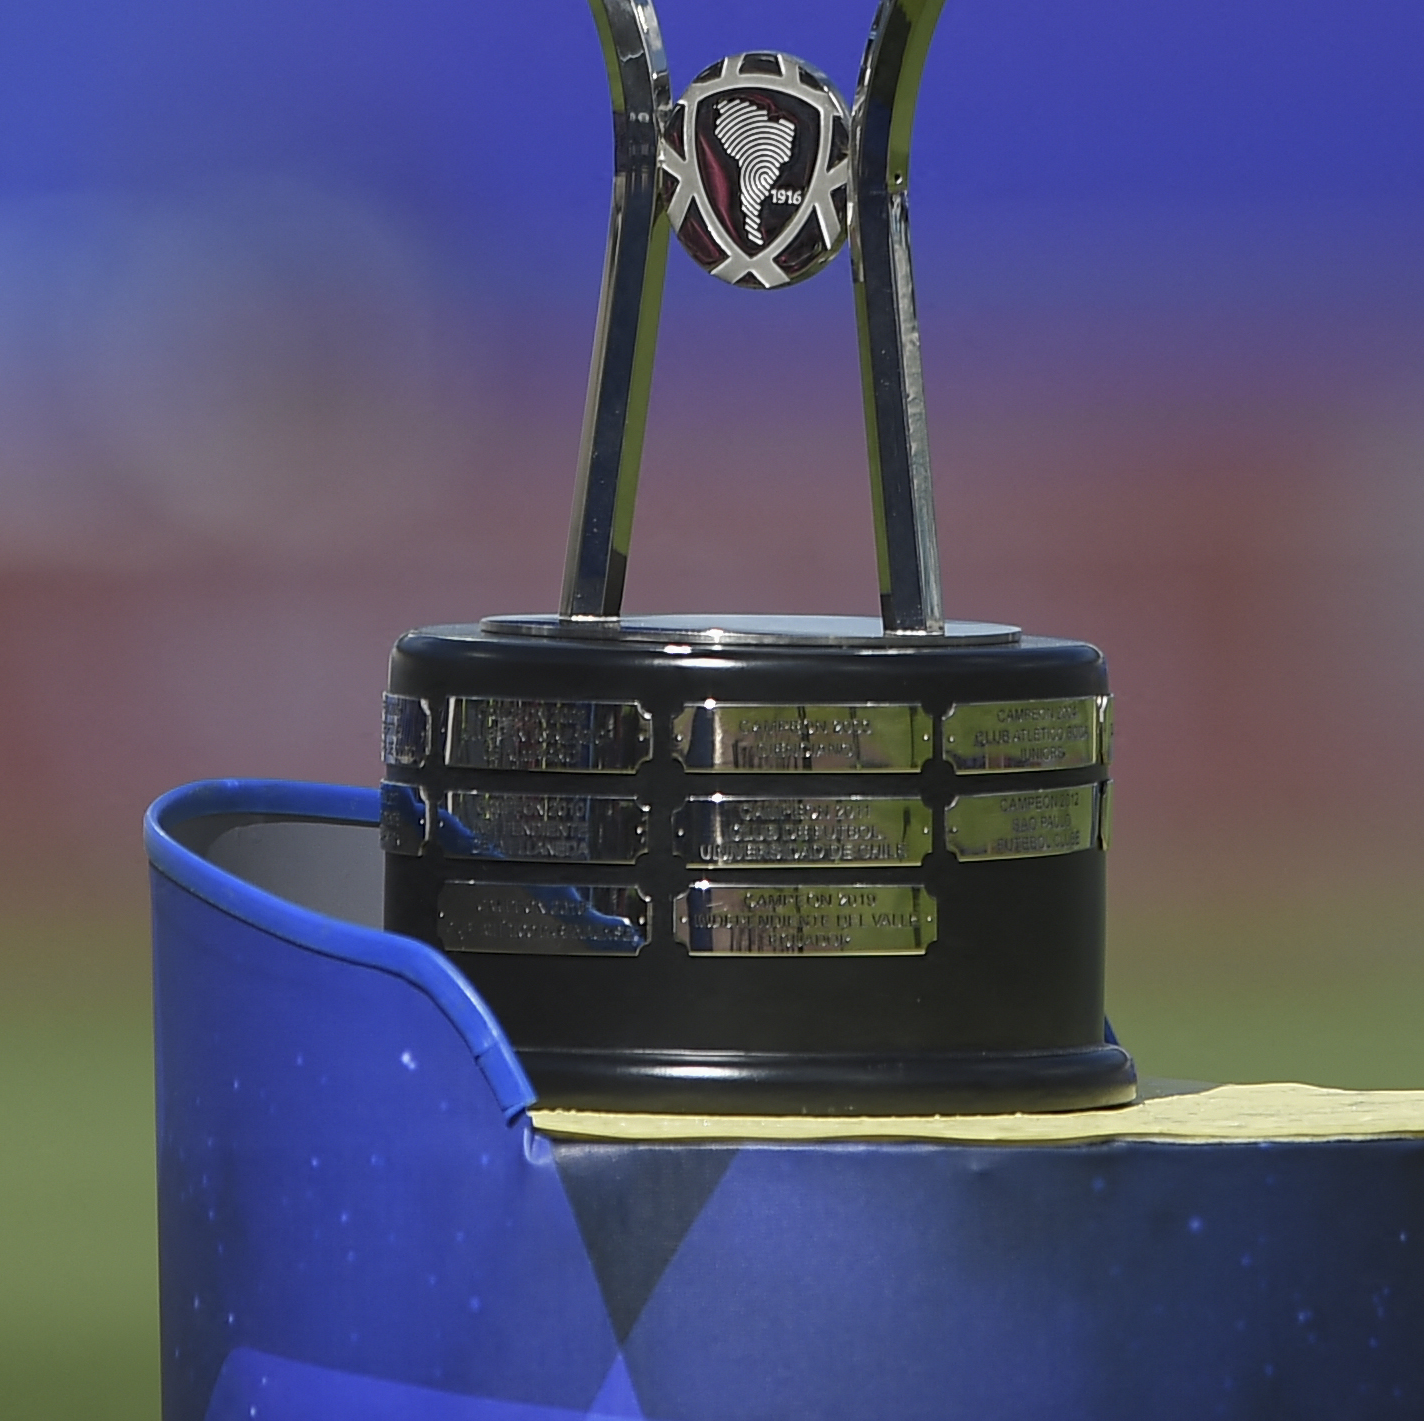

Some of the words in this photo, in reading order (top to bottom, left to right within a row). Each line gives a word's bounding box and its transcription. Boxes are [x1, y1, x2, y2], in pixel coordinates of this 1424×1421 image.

[770, 189, 802, 205] 1916
[997, 707, 1055, 724] CAMPEON
[974, 729, 1010, 747] CLUB
[1012, 726, 1064, 743] ATLETICO
[1001, 793, 1058, 812] CAMPEON
[1059, 792, 1080, 808] 2012
[835, 803, 872, 820] 2011
[829, 843, 854, 861] DE
[858, 842, 909, 860] CHILE
[743, 892, 833, 908] CAMPEON
[838, 892, 877, 908] 2019
[693, 913, 829, 929] INDEPENDIENTE
[835, 913, 867, 928] DEL
[871, 912, 918, 928] VALLE
